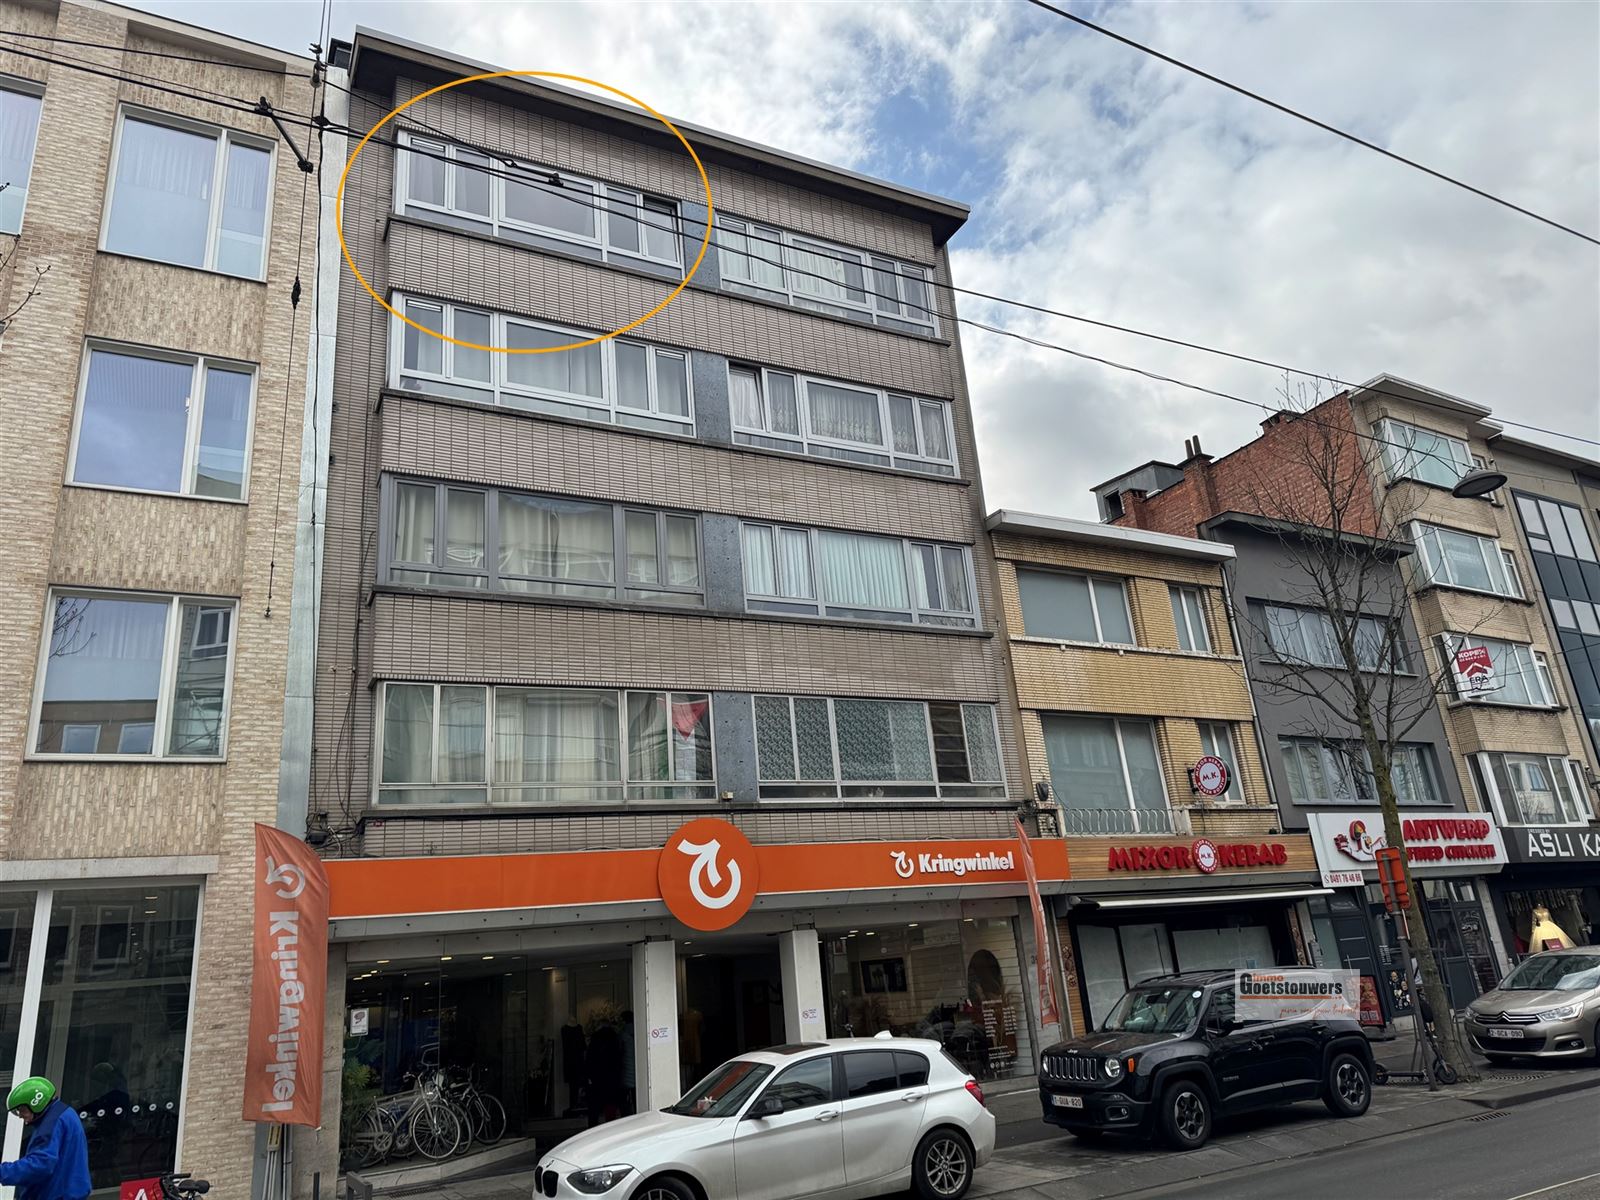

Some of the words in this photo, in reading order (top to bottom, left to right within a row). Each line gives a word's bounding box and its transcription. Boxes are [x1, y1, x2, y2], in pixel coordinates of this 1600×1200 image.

[1469, 675, 1489, 684] ERA
[1402, 819, 1490, 841] ANTWERP
[1405, 846, 1444, 861] FRIED
[1445, 844, 1496, 860] CHICKEN
[1528, 833, 1575, 857] ASLI
[918, 851, 1015, 876] Kringwinkel
[1108, 846, 1190, 871] MIXOR
[1217, 843, 1288, 867] KEBAB
